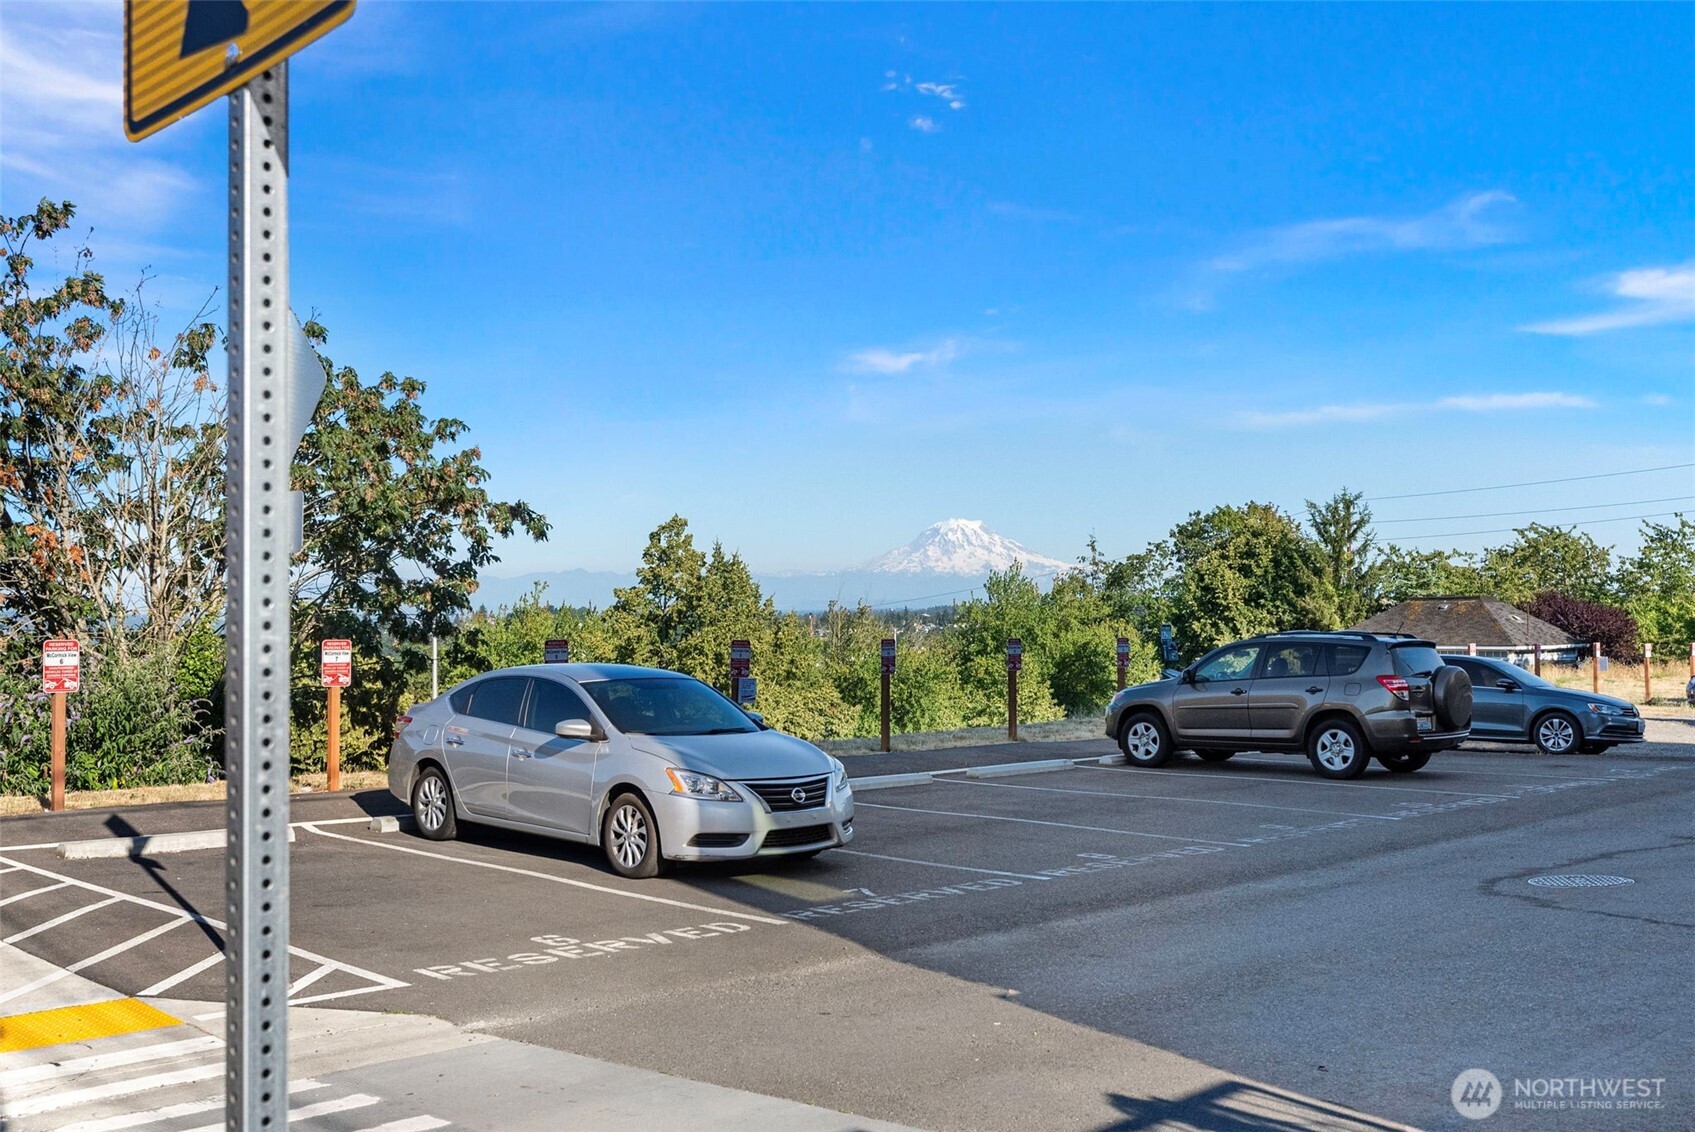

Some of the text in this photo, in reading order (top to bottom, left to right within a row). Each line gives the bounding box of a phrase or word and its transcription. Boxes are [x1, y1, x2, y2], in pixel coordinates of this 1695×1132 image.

[779, 878, 1023, 920] RESERVED
[412, 922, 752, 980] RESERVED
[529, 934, 581, 946] 6
